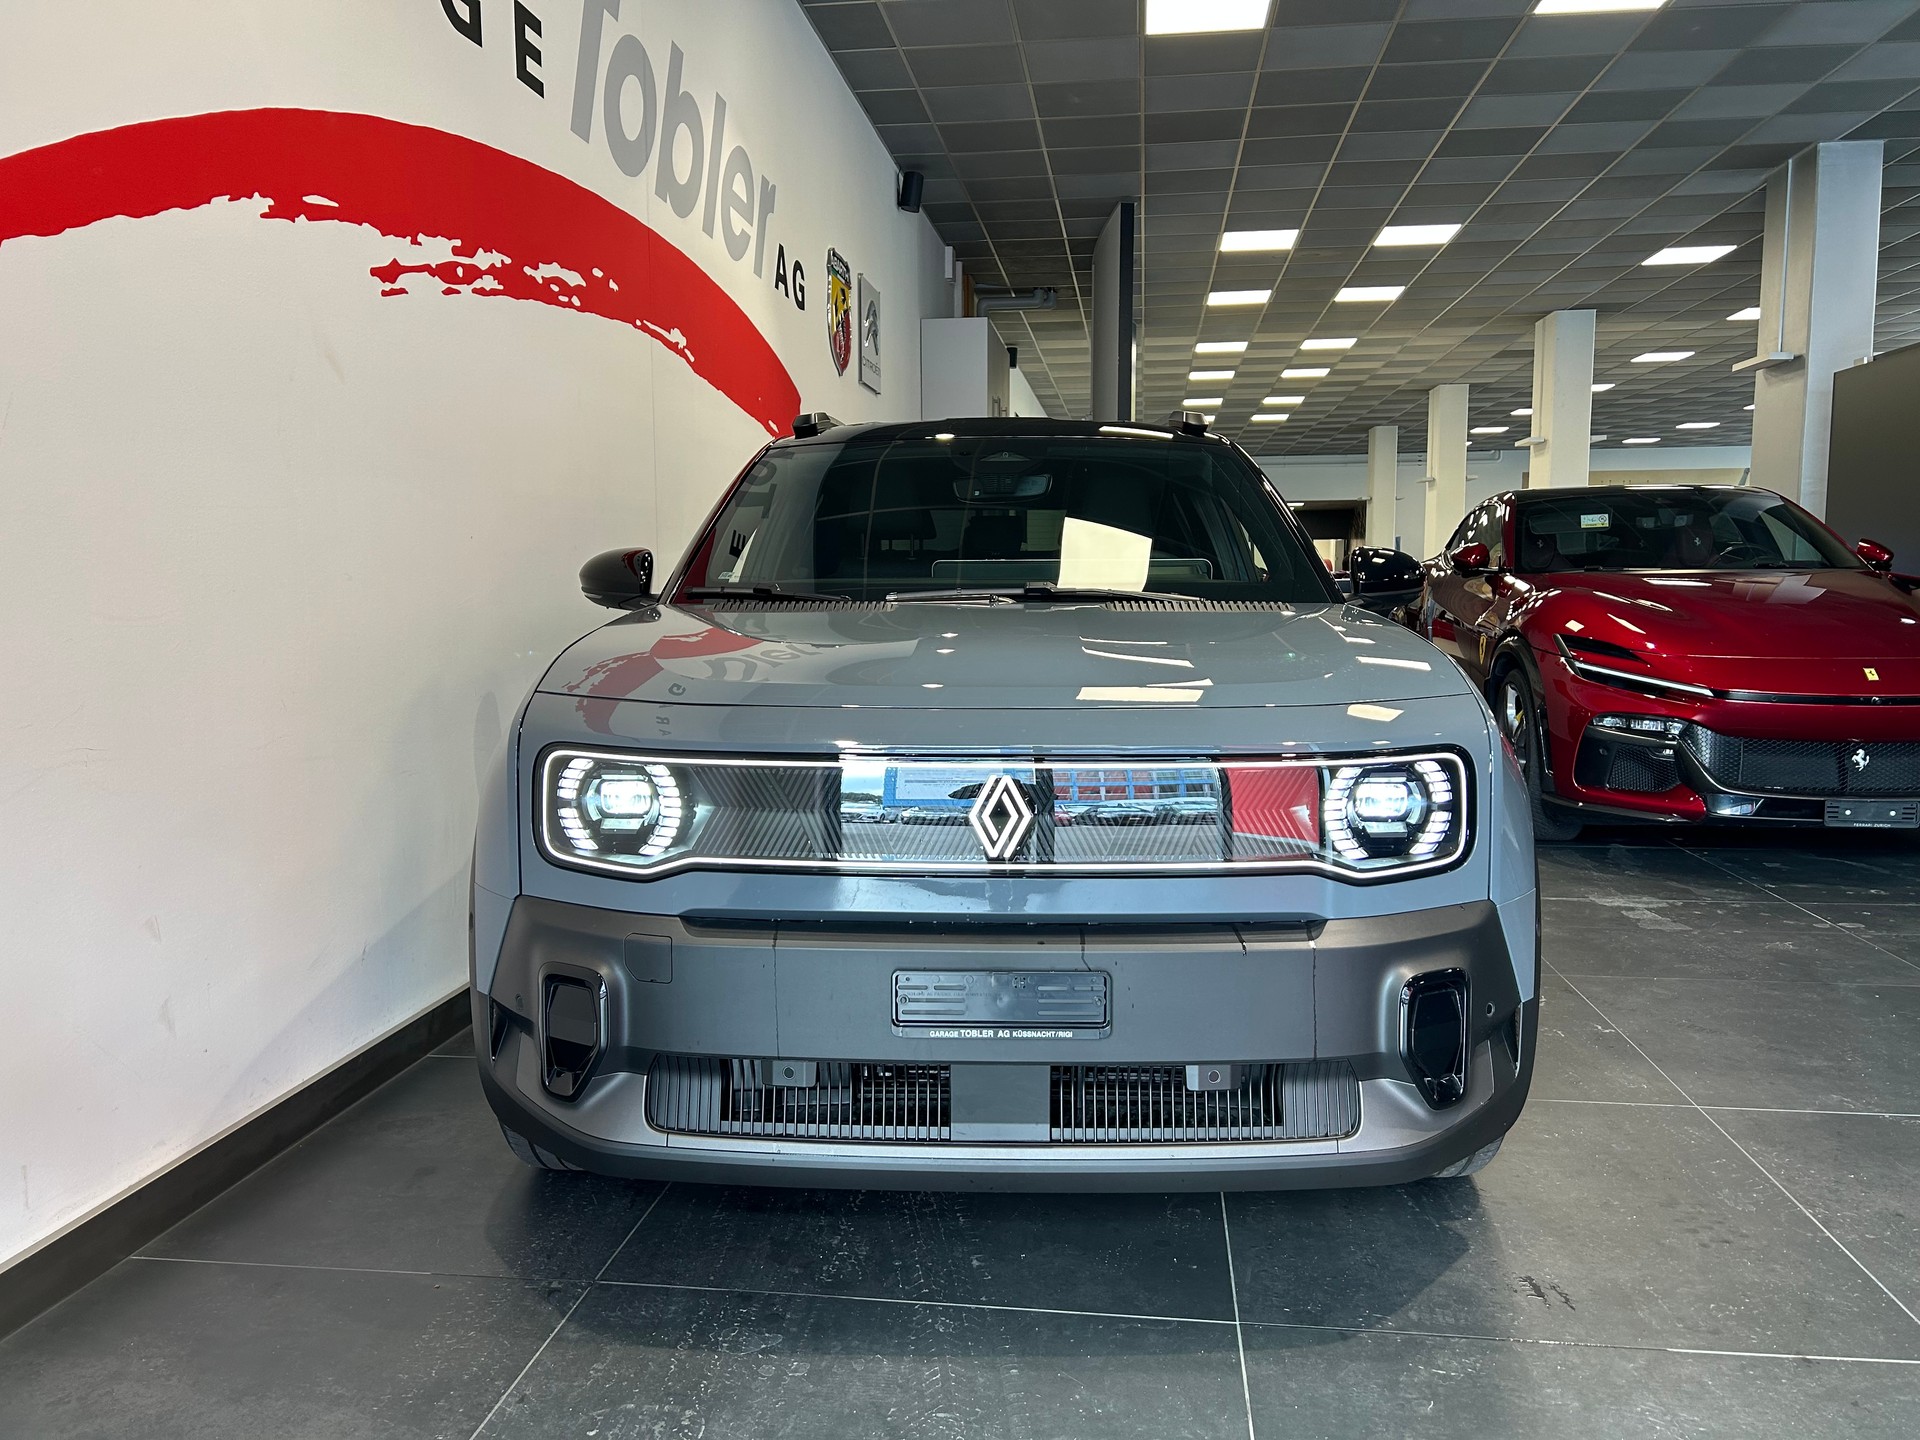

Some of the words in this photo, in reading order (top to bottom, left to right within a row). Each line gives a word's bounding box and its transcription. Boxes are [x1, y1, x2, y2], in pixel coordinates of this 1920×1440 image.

[570, 0, 777, 279] Tobler
[775, 243, 806, 311] AG
[929, 1030, 958, 1038] GARAGE
[960, 1029, 994, 1038] TOBLER
[997, 1029, 1010, 1038] AG
